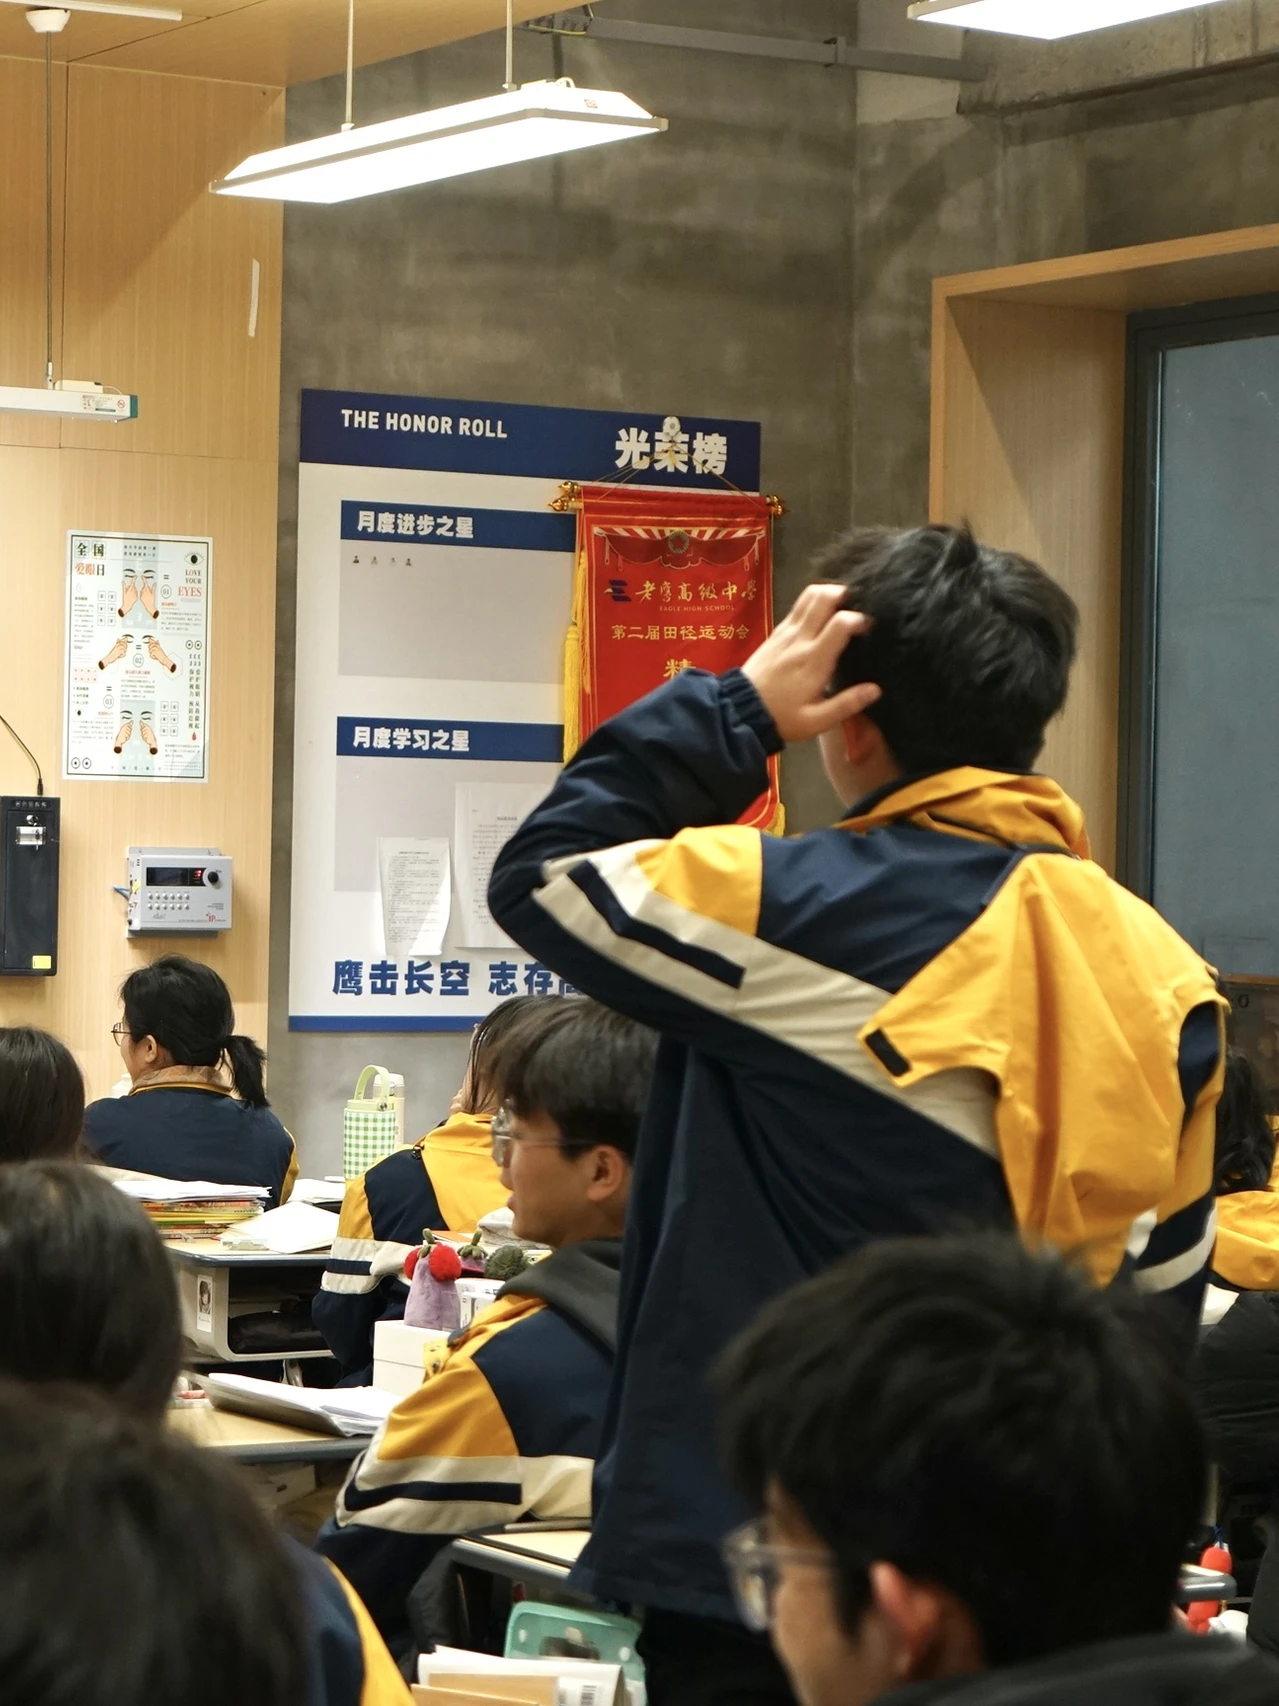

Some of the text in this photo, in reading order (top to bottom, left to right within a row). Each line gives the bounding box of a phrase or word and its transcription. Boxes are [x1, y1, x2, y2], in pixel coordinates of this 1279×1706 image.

[341, 409, 508, 438] THE HONOR ROLL
[615, 427, 728, 476] 光荣榜
[357, 510, 474, 539] 月度进步之星
[76, 542, 105, 557] 全国
[178, 587, 202, 597] EYES
[659, 604, 681, 612] EAGLE
[611, 624, 750, 641] 第二届田径运动会
[353, 726, 470, 754] 月度学习之星
[332, 960, 470, 996] 鹰击长空
